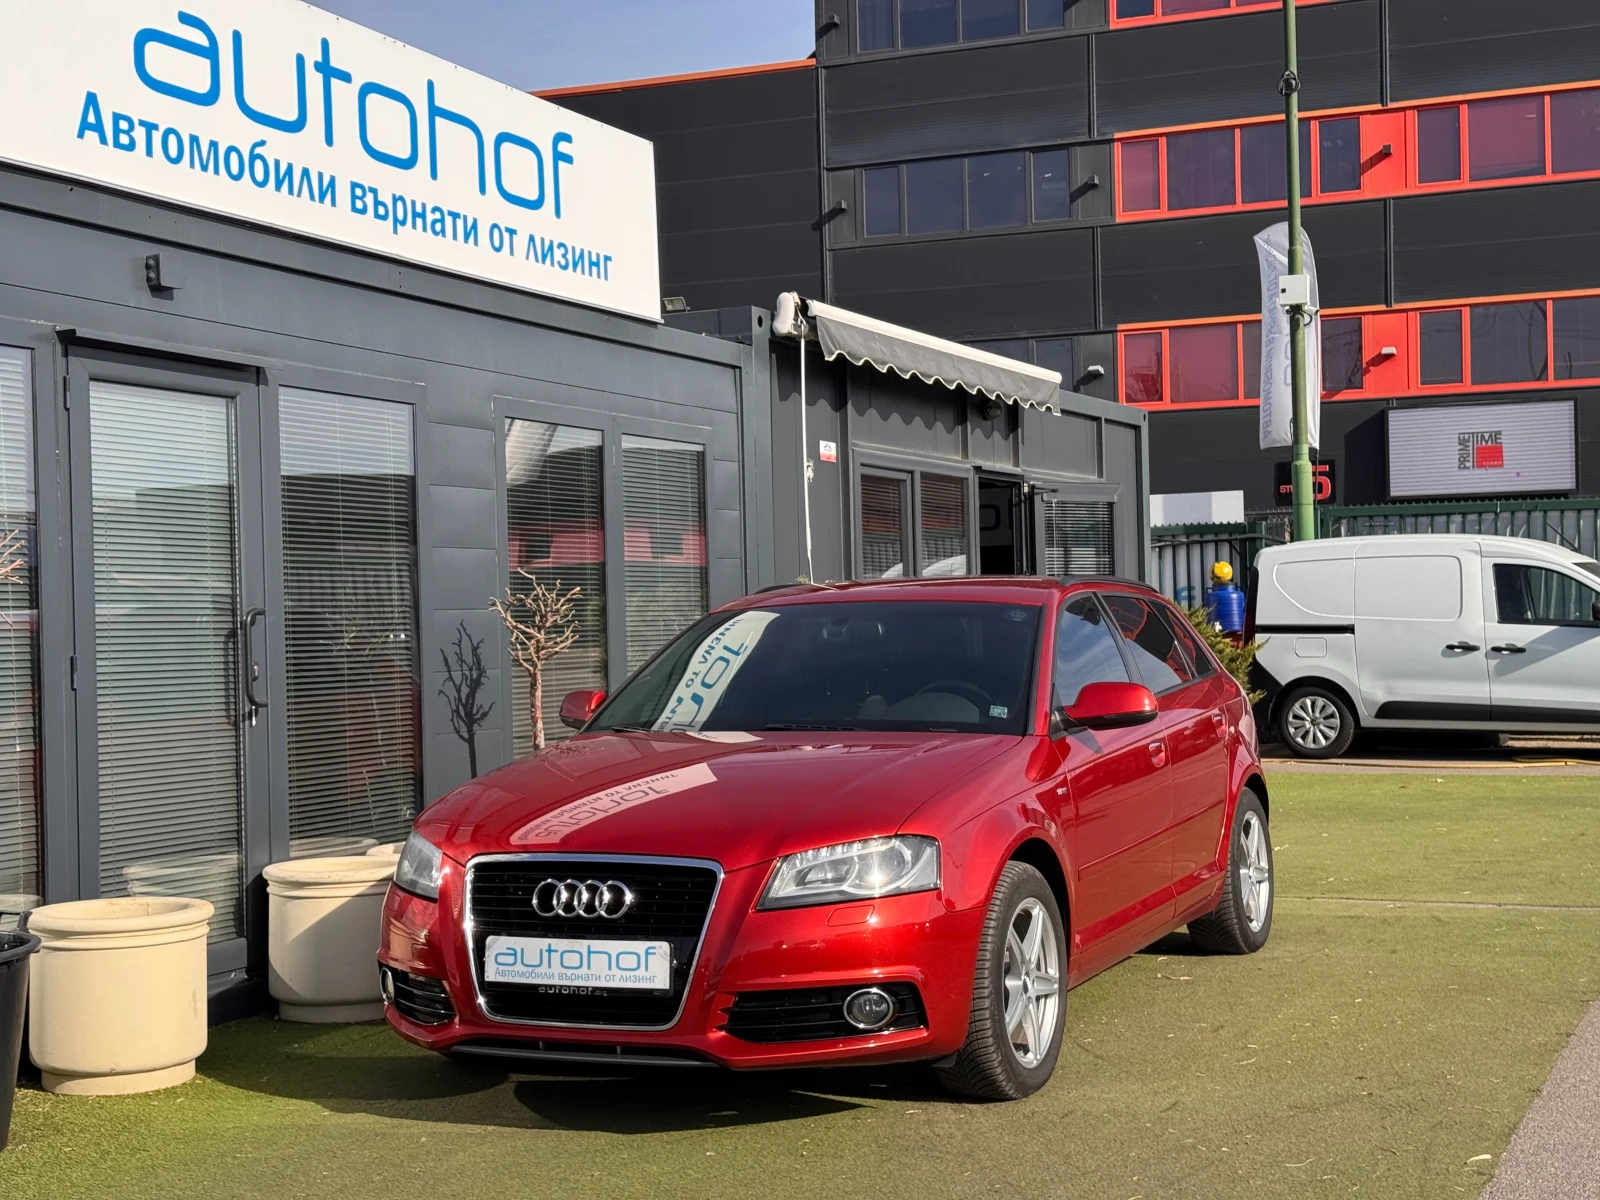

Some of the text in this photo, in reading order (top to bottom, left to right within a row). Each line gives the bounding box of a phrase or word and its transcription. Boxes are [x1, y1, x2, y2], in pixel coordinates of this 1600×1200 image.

[133, 10, 574, 218] autohof
[77, 91, 613, 281] Автомобили върнати от лизинг
[1458, 433, 1471, 469] PRIME
[1312, 464, 1332, 500] 5
[494, 943, 657, 972] autohof
[495, 967, 657, 984] Автомобили върнати от лизинг
